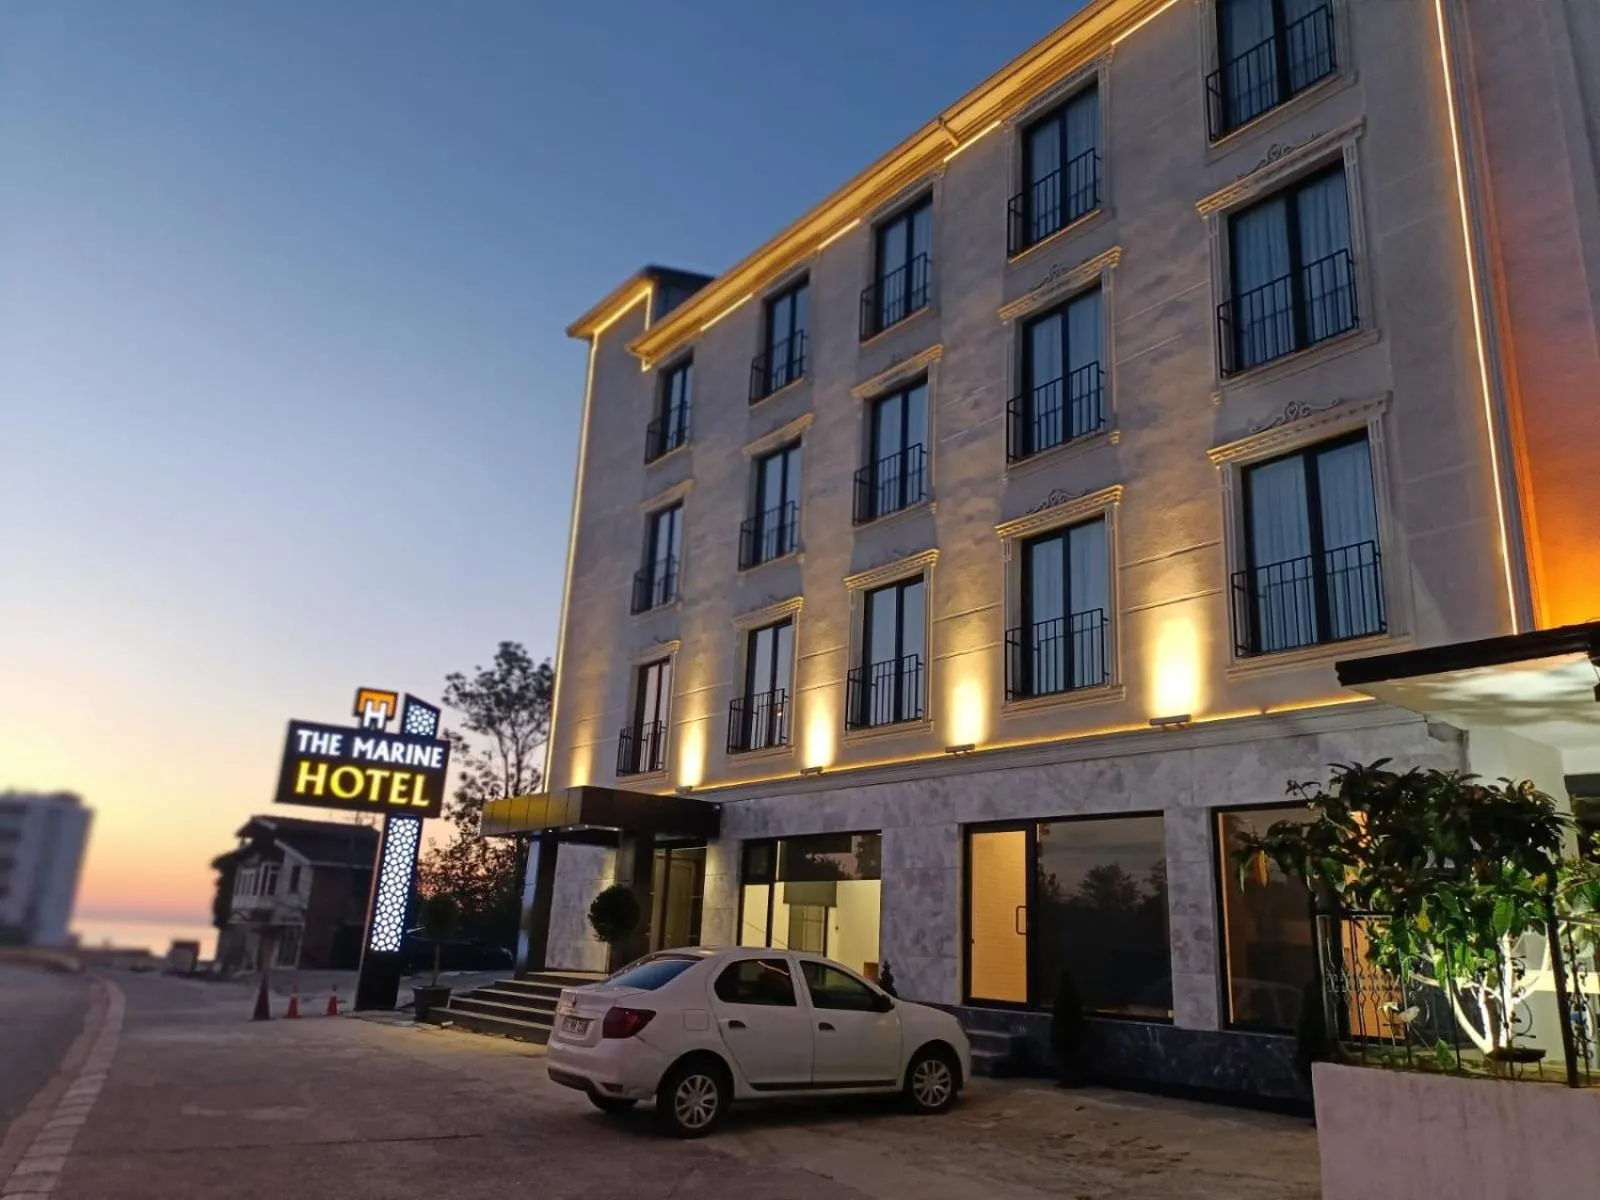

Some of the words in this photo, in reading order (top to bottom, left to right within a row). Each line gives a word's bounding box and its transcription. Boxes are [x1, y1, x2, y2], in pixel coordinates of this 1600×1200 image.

[297, 729, 342, 756] THE
[352, 736, 443, 768] MARINE
[295, 760, 430, 807] HOTEL
